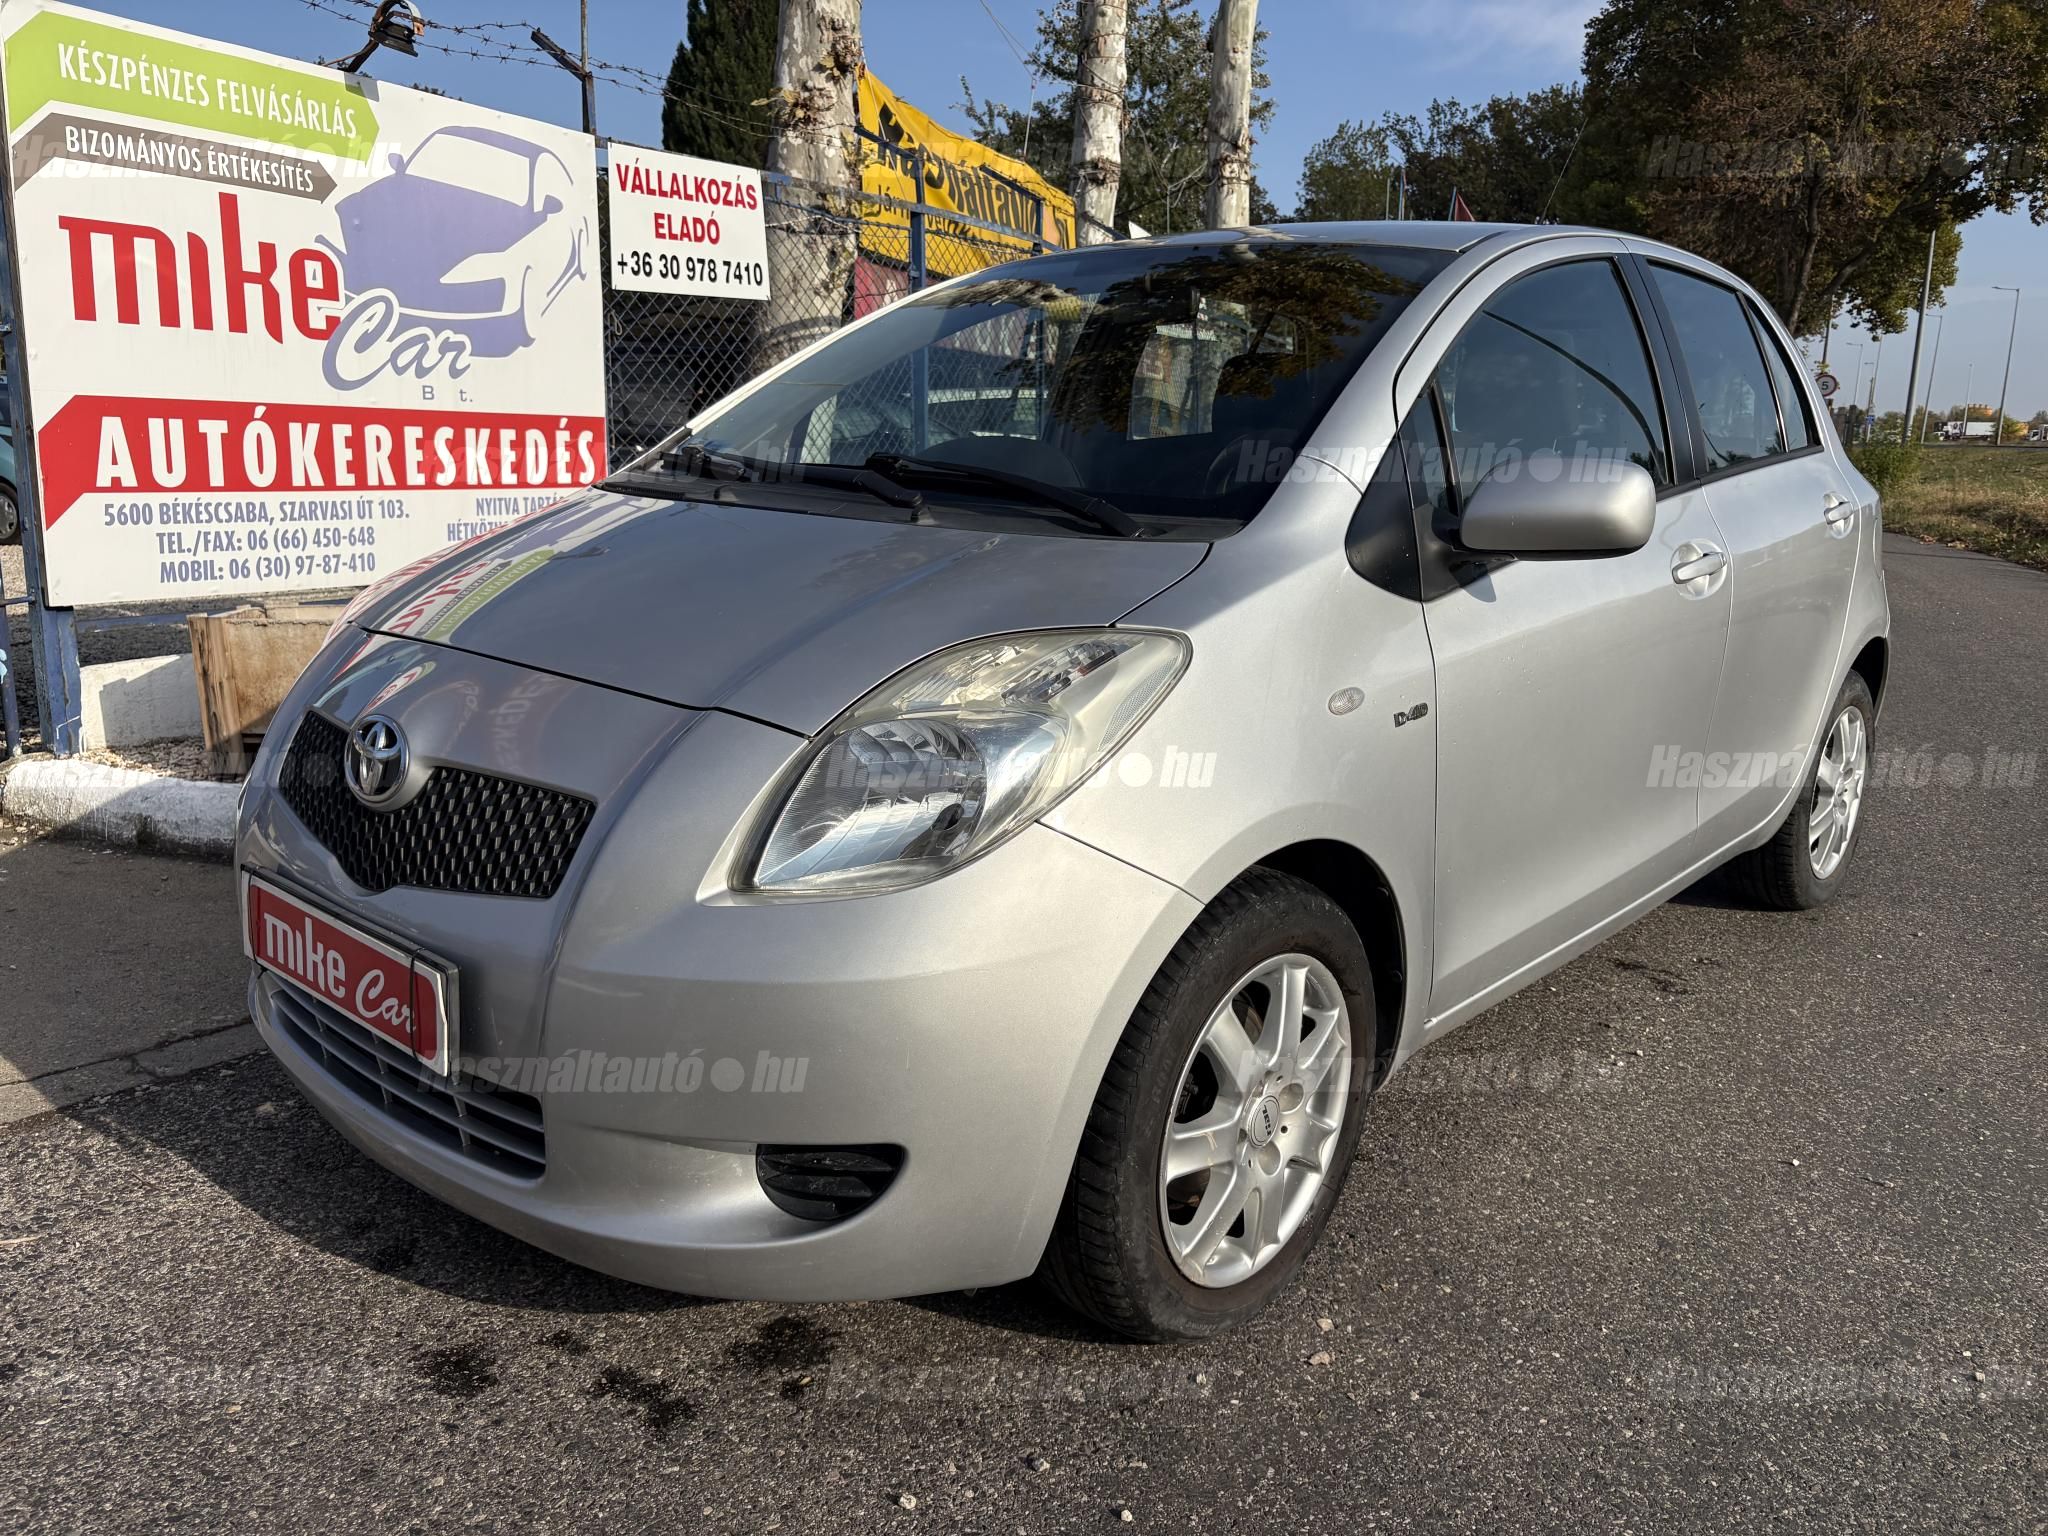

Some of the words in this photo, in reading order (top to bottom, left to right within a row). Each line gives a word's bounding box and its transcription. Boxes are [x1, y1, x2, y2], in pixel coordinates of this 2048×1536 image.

[57, 40, 210, 107] KÉSZPÉNZES
[216, 78, 358, 139] FELVÁSÁRLÁS
[65, 125, 202, 173] BIZOMÁNYOS
[208, 146, 314, 193] ÉRTÉKESÍTÉS
[616, 157, 758, 210] VÁLLALKOZÁS
[654, 210, 721, 245] ELADÓ
[58, 191, 342, 345] mike
[617, 250, 653, 277] +36
[659, 253, 681, 280] 30
[686, 256, 718, 283] 978
[723, 260, 763, 286] 7410
[322, 295, 471, 391] Car
[96, 405, 596, 488] AUTÓKERESKEDÉS
[104, 502, 154, 526] 5600
[158, 497, 275, 526] BÉKÉSCSABA,
[279, 500, 353, 522] SZARVASI
[357, 495, 374, 520] ÚT
[378, 499, 410, 519] 103.
[476, 497, 520, 516] NYITVA
[523, 492, 564, 514] TARTÁ
[155, 530, 243, 556] TEL./FAX:
[247, 529, 269, 551] 06
[273, 527, 308, 553] (66)
[313, 526, 375, 548] 450-648
[160, 559, 224, 583] MOBIL:
[229, 557, 251, 580] 06
[256, 555, 291, 581] (30)
[295, 552, 376, 576] 97-87-410
[263, 912, 346, 998] mike
[355, 968, 417, 1034] Car
